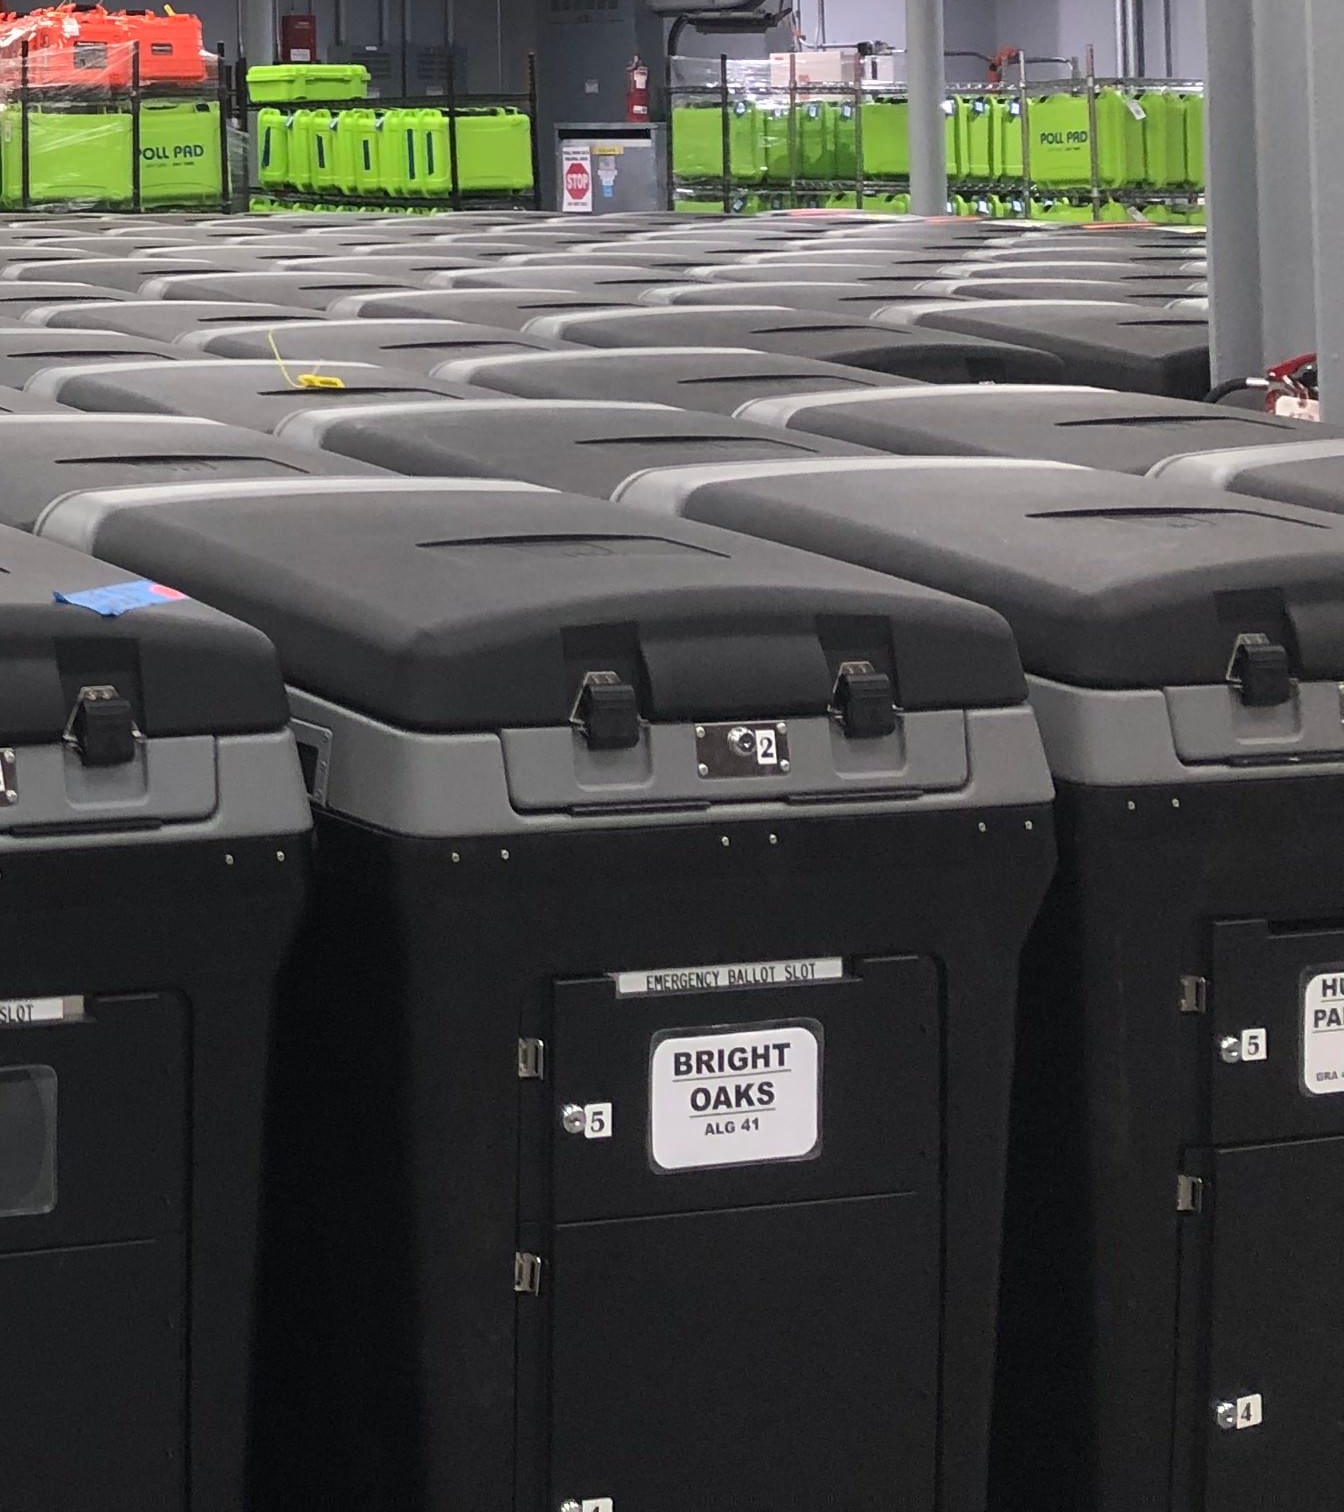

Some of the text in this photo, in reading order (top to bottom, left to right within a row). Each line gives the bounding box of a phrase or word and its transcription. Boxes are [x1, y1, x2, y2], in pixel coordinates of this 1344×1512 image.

[1040, 131, 1088, 144] POLL PAD
[139, 145, 204, 160] OLL PAD
[566, 173, 589, 189] STOP
[759, 736, 774, 758] 2
[646, 963, 816, 991] EMERGENCY BALLOT SLOT
[0, 1004, 34, 1023] SLOT
[1314, 1007, 1344, 1028] PA
[1247, 1035, 1260, 1056] 5
[673, 1042, 791, 1076] BRIGHT
[690, 1081, 775, 1112] OAKS
[590, 1111, 605, 1133] 5
[704, 1117, 759, 1136] ALG 41
[1240, 1402, 1253, 1421] 4
